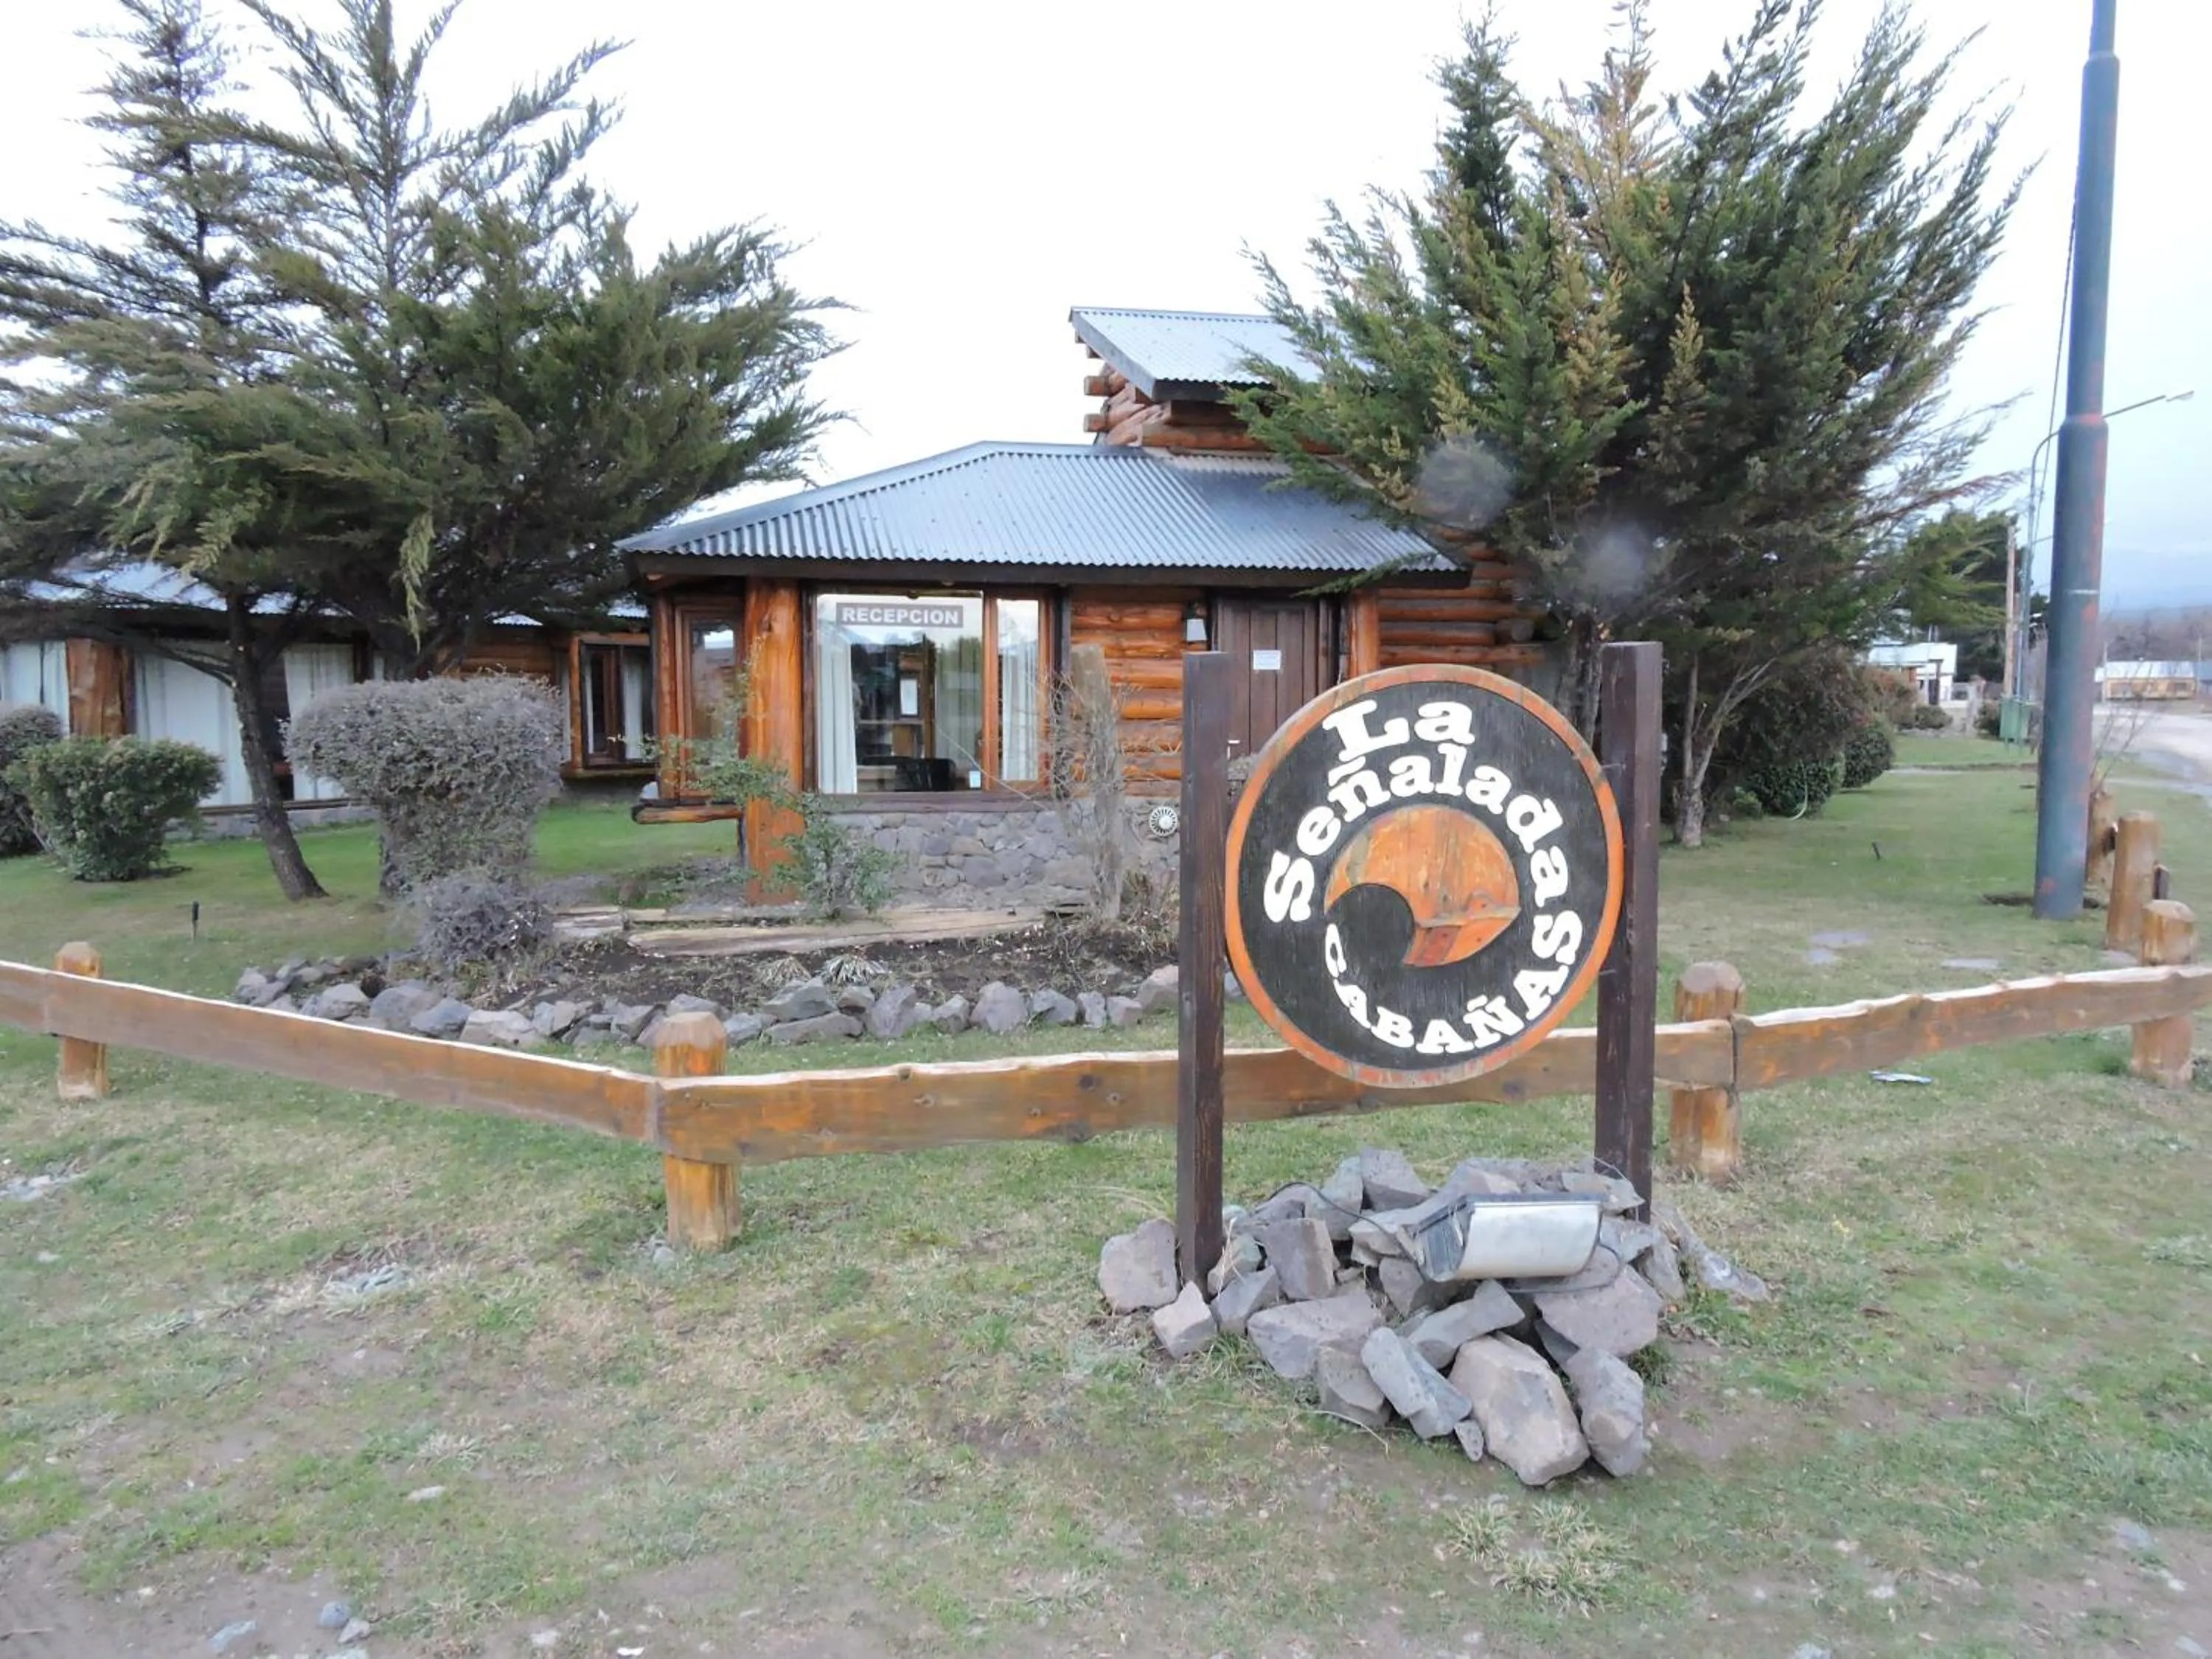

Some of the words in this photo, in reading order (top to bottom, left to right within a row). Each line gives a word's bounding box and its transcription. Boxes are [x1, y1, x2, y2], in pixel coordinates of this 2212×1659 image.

[843, 607, 959, 625] RECEPCION
[1323, 700, 1475, 762] La
[1325, 910, 1583, 1054] CABAÑAS
